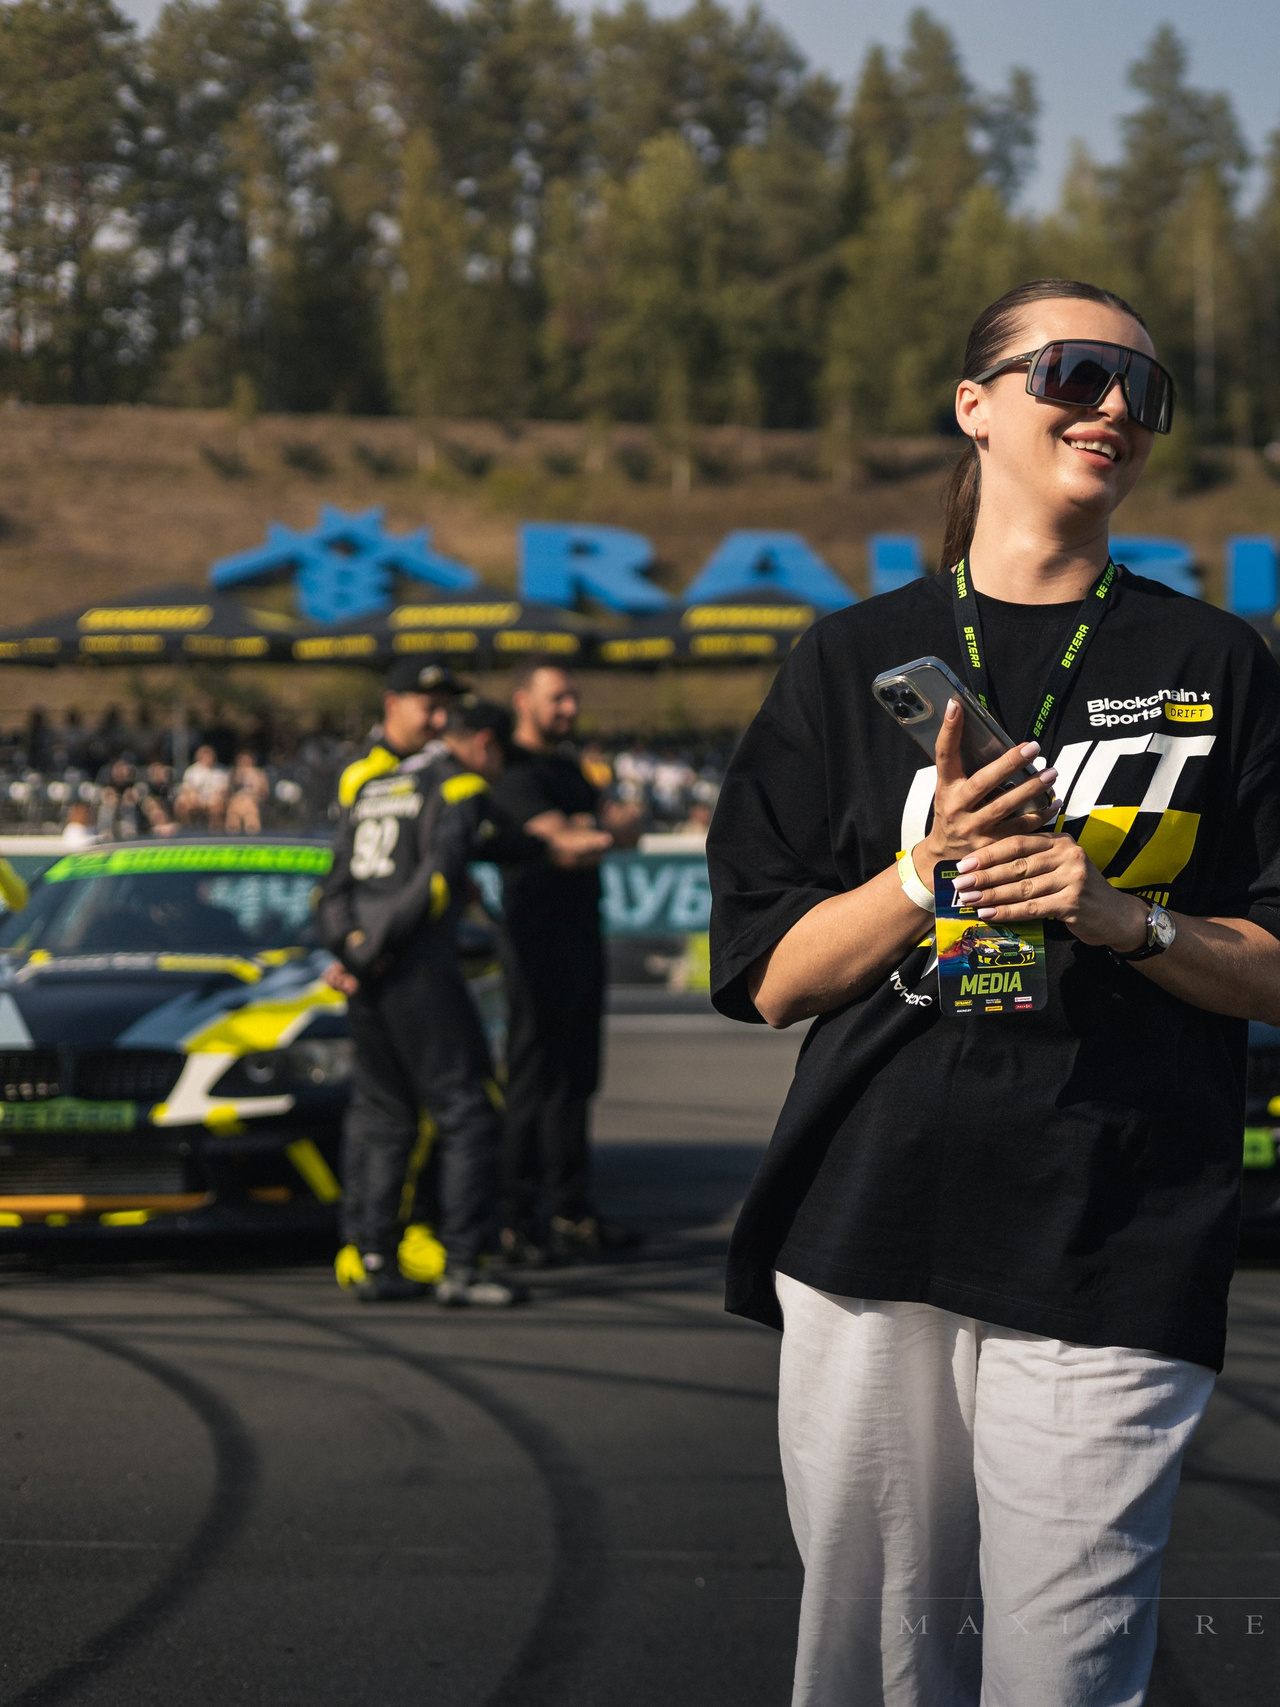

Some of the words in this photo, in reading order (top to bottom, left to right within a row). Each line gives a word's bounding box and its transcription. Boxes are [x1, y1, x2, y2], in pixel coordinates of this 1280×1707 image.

[1089, 706, 1162, 728] Sports
[1170, 707, 1206, 718] DRIFT
[959, 971, 1023, 996] MEDIA
